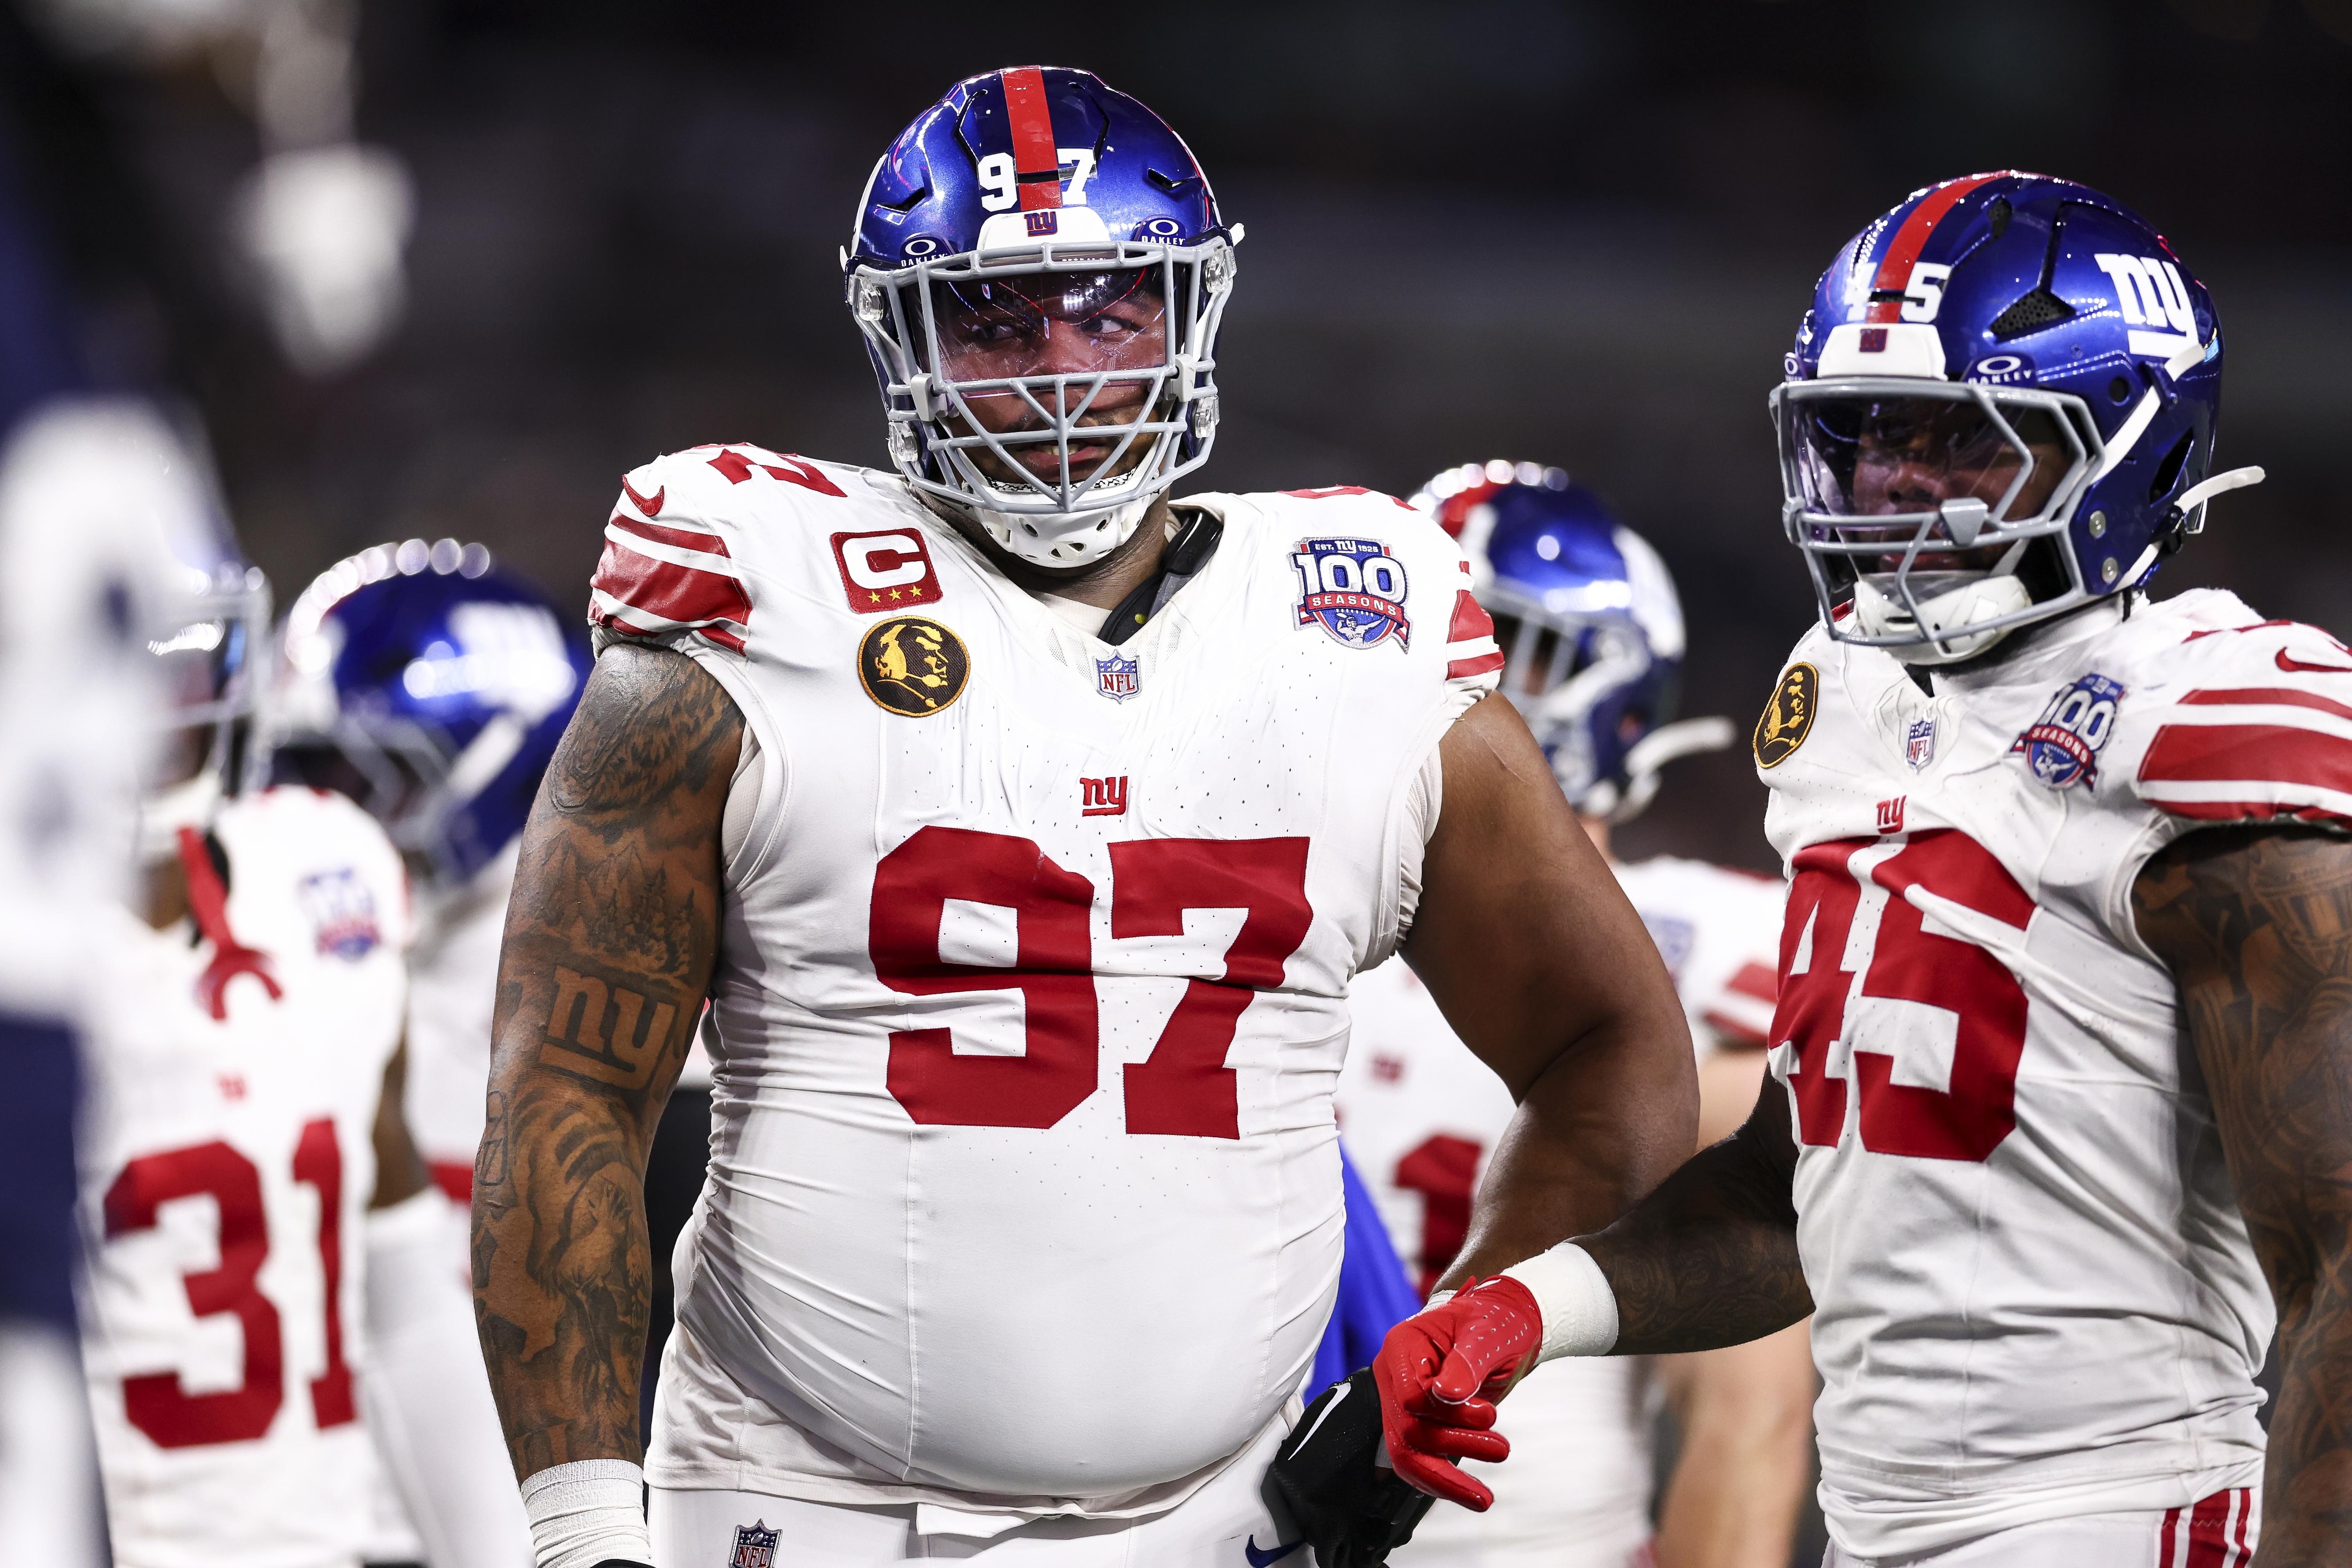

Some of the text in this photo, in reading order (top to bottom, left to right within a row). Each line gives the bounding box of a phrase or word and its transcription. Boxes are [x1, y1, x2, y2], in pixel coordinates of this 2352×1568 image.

[978, 148, 1095, 212] 97
[1141, 235, 1184, 245] OAKLEY
[842, 534, 926, 589] C
[1295, 554, 1405, 604] 100
[1312, 595, 1397, 616] SEASONS
[1103, 673, 1136, 693] NFL
[2036, 682, 2114, 751] 100
[1908, 740, 1929, 761] NFL
[2032, 727, 2088, 763] SEASONS
[868, 825, 1313, 1140] 97
[1768, 828, 2042, 1163] 45
[103, 1113, 356, 1451] 31
[736, 1546, 770, 1568] NFL
